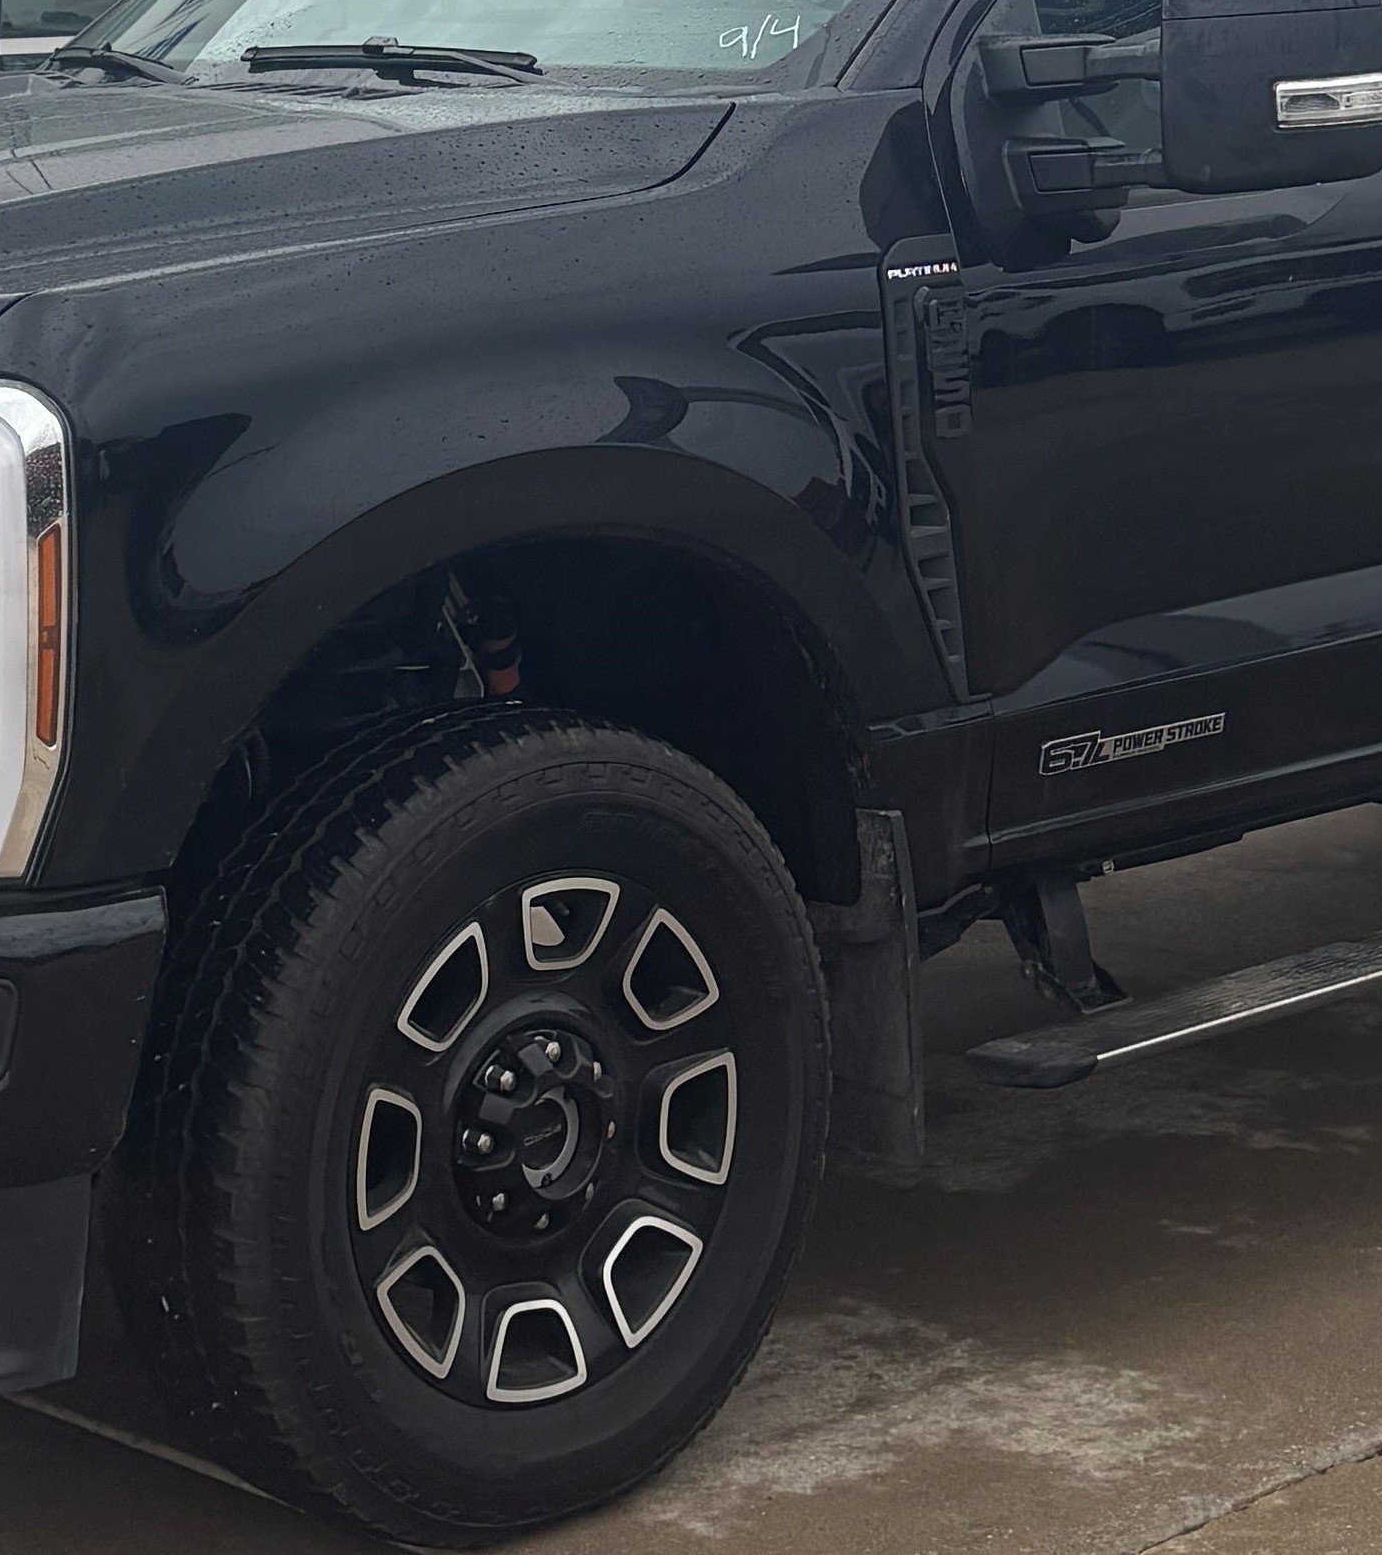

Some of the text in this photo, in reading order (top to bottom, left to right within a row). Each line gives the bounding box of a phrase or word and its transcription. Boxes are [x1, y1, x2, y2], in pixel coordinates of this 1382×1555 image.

[719, 14, 801, 58] 9/4
[1113, 728, 1164, 754] POWER
[1166, 715, 1224, 743] STROKE
